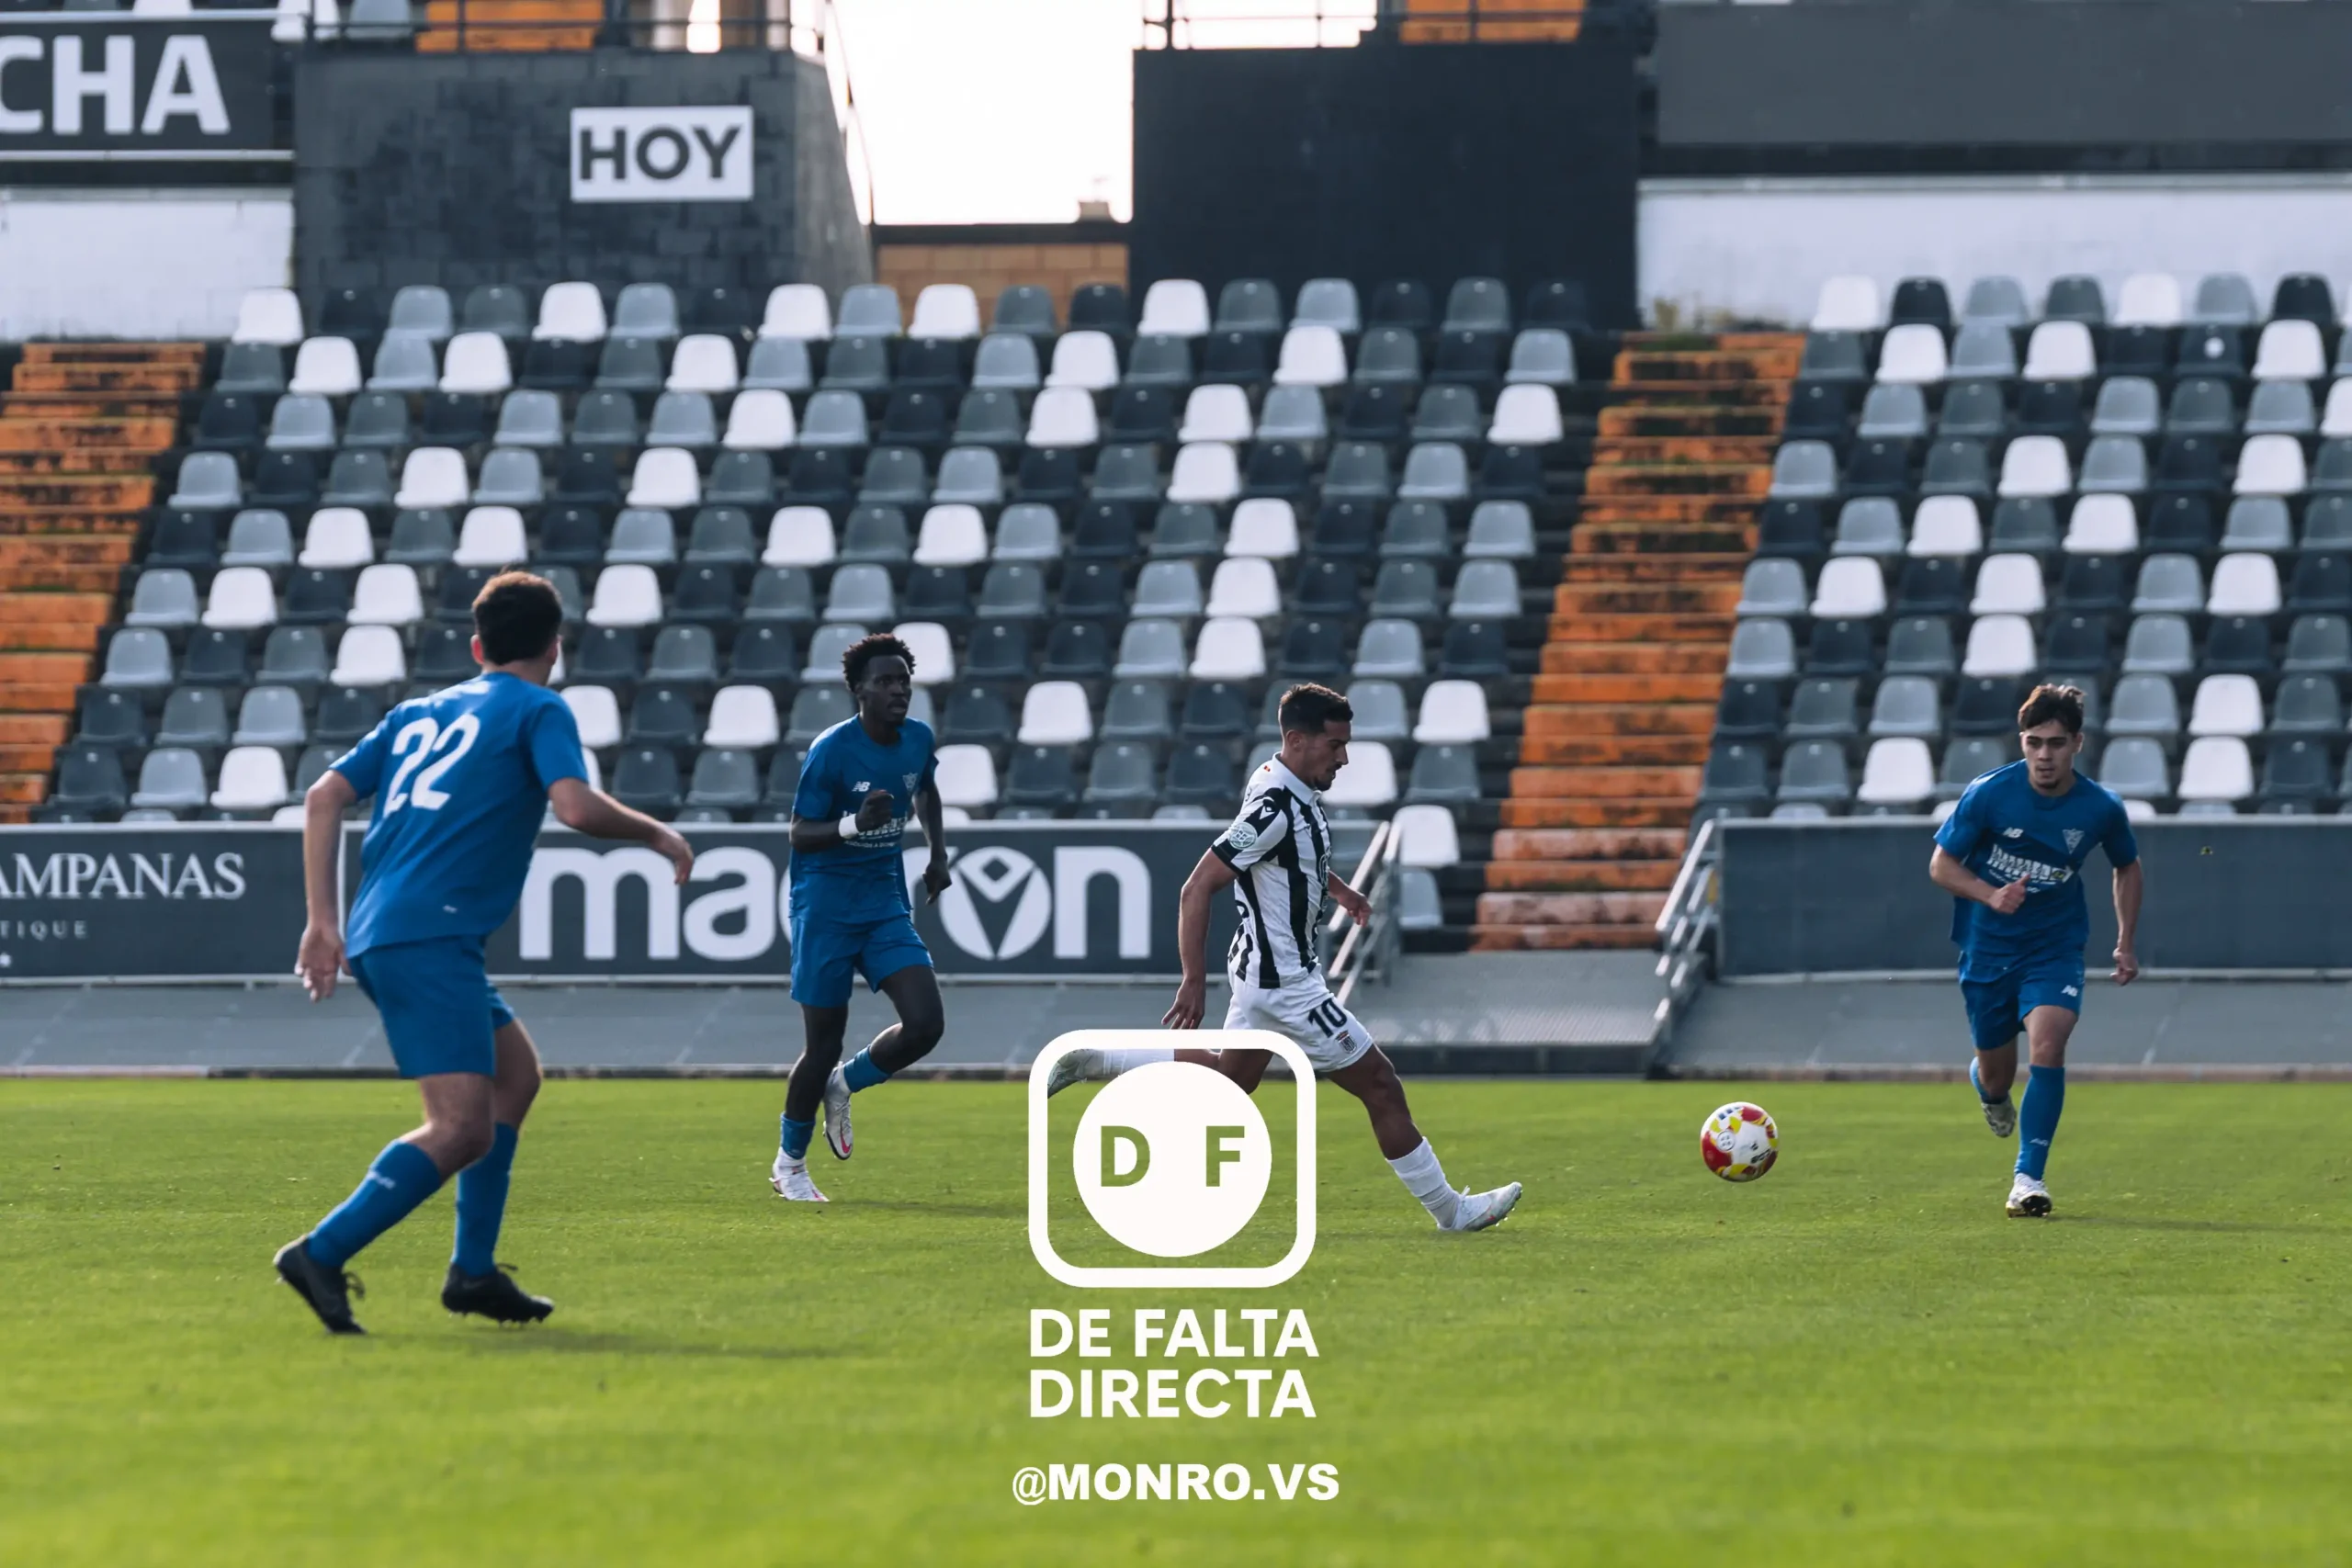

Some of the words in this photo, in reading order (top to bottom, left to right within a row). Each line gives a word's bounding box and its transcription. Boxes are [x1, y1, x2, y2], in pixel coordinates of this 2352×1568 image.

[580, 127, 741, 181] HOY
[383, 713, 481, 818] 22
[518, 846, 1151, 961] maon
[1307, 998, 1348, 1038] 10
